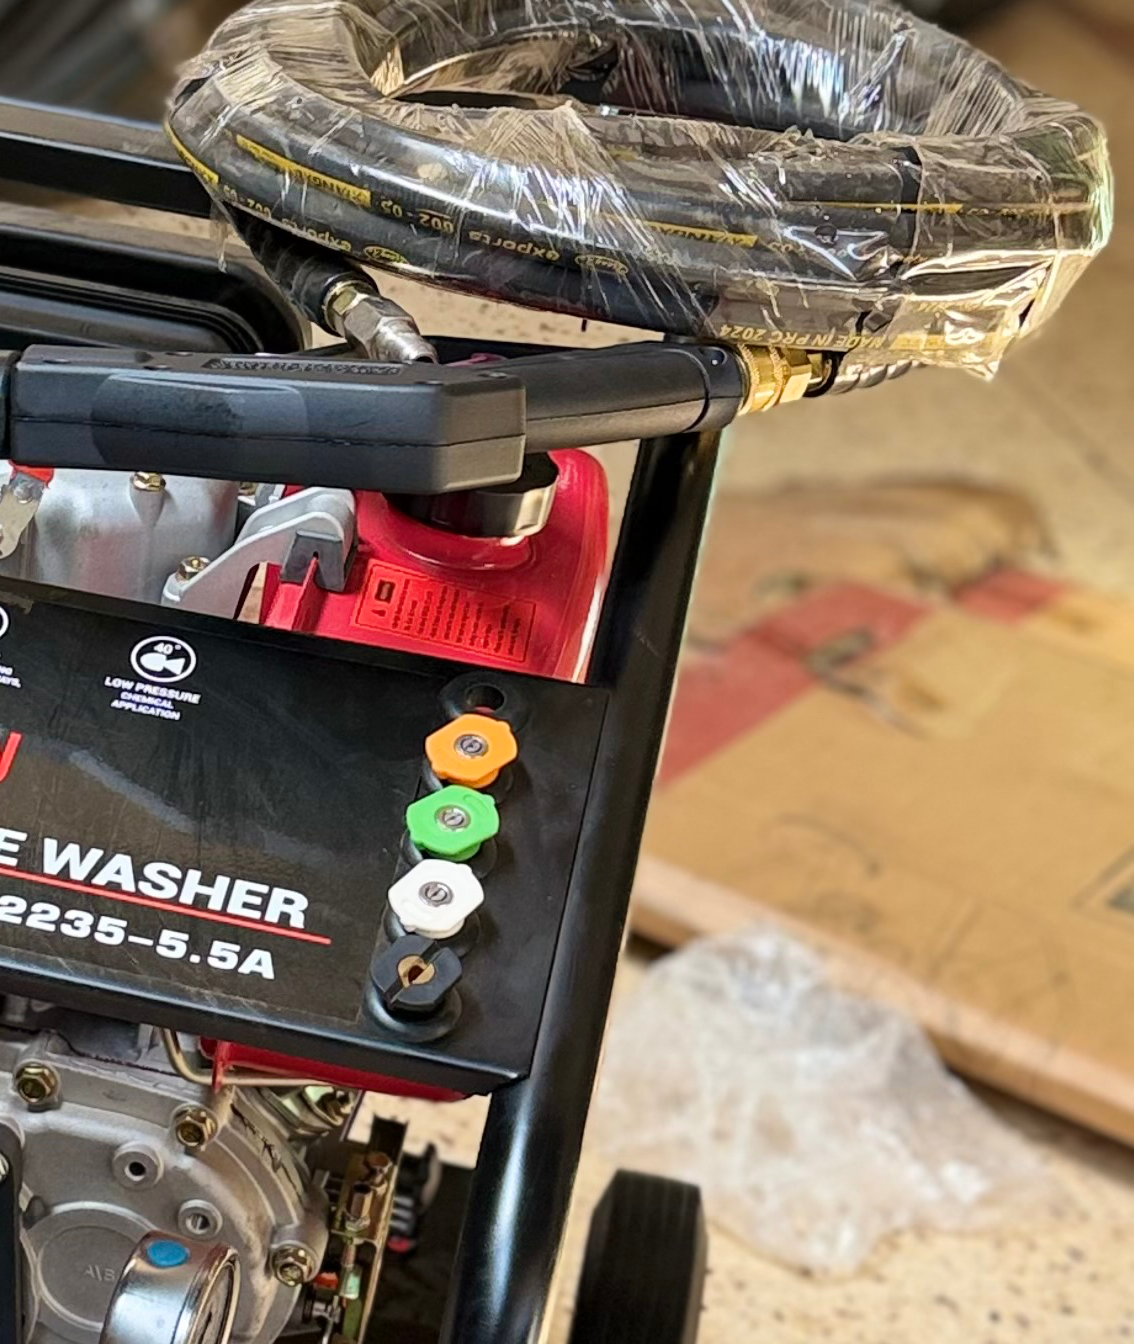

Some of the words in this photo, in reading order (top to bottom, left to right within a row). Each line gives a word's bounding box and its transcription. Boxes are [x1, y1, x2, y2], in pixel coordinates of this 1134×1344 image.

[720, 323, 767, 340] 2024
[768, 331, 809, 346] PRC
[810, 333, 835, 347] IN
[835, 333, 887, 349] MADE
[104, 676, 135, 690] LOW
[134, 682, 202, 704] PRESSURE
[120, 691, 174, 709] CHEMICAL
[110, 699, 181, 721] APPLICATION
[41, 837, 311, 930] WASHER
